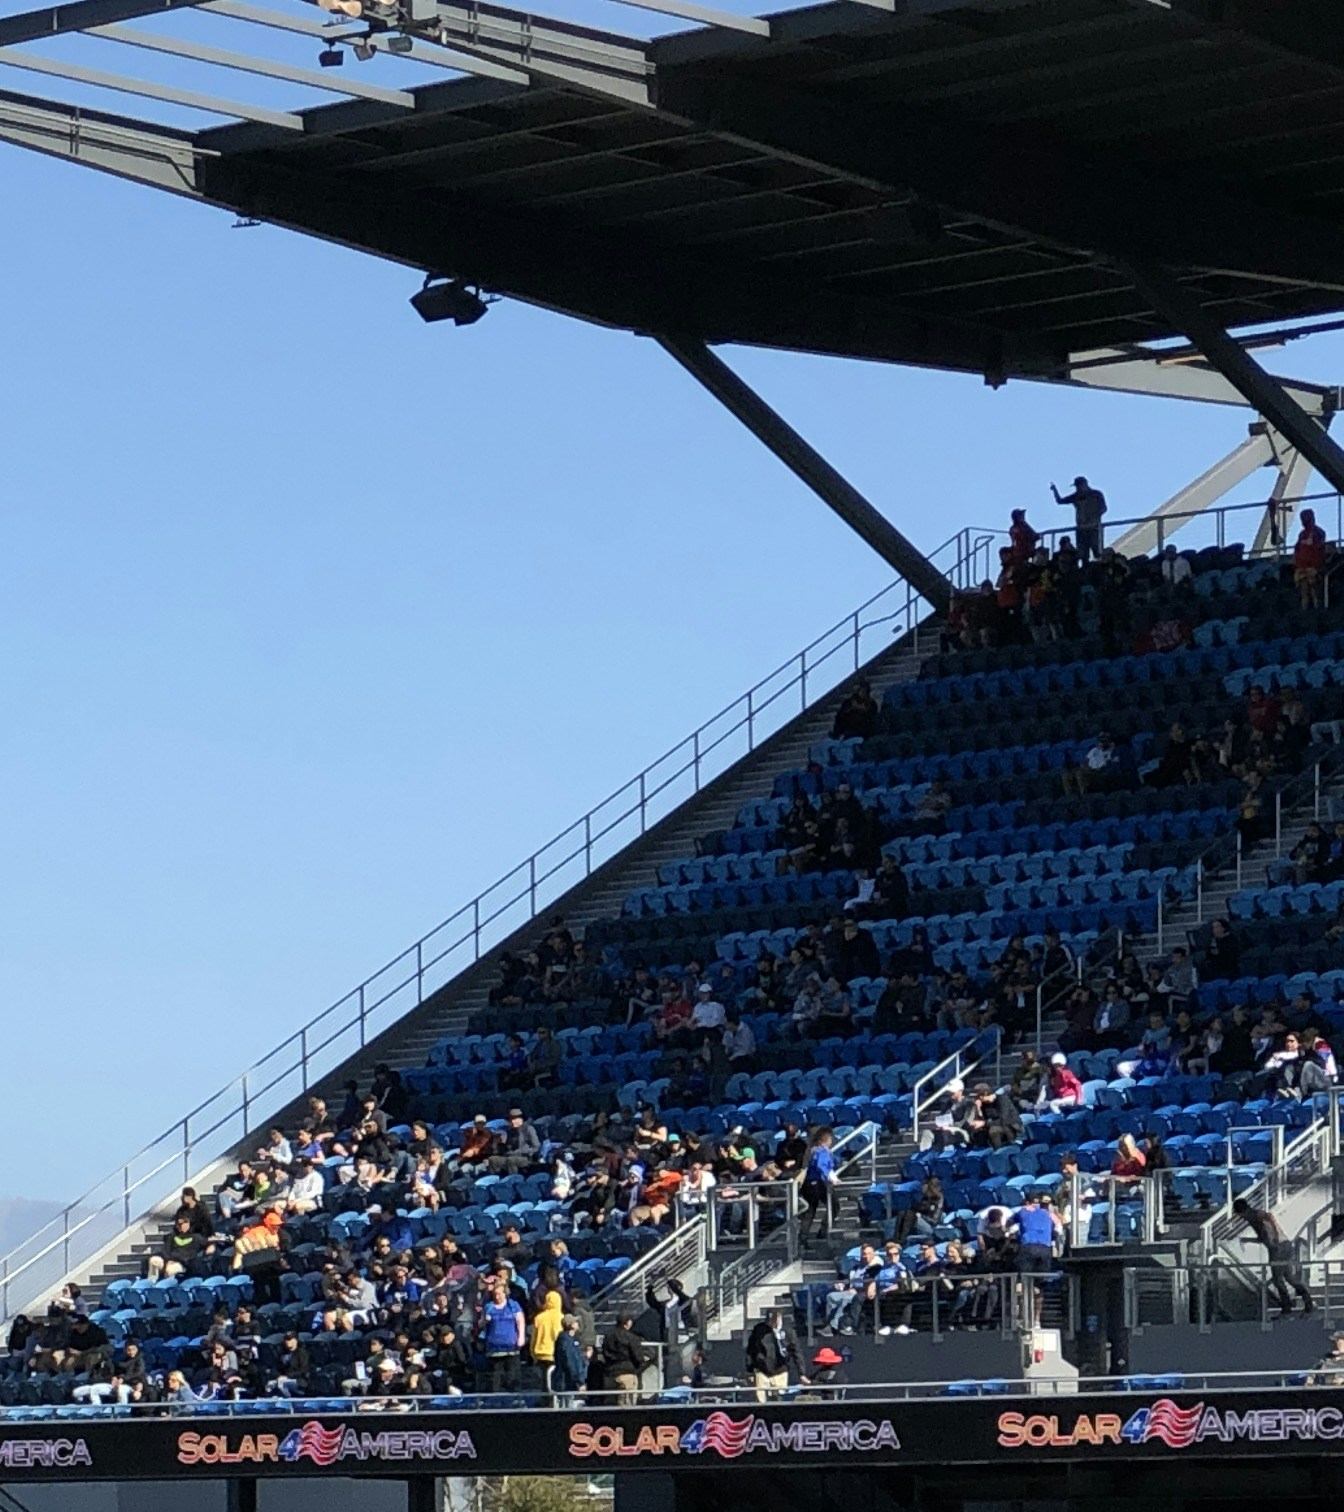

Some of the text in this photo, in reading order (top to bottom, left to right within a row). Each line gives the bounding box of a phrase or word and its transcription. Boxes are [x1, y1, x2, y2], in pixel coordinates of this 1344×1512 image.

[177, 1431, 279, 1465] SOLAR
[337, 1427, 477, 1461] AMERICA
[569, 1423, 681, 1457] SOLAR
[746, 1419, 901, 1453] AMERICA
[998, 1412, 1122, 1448] SOLAR
[1195, 1406, 1344, 1442] AMERIC
